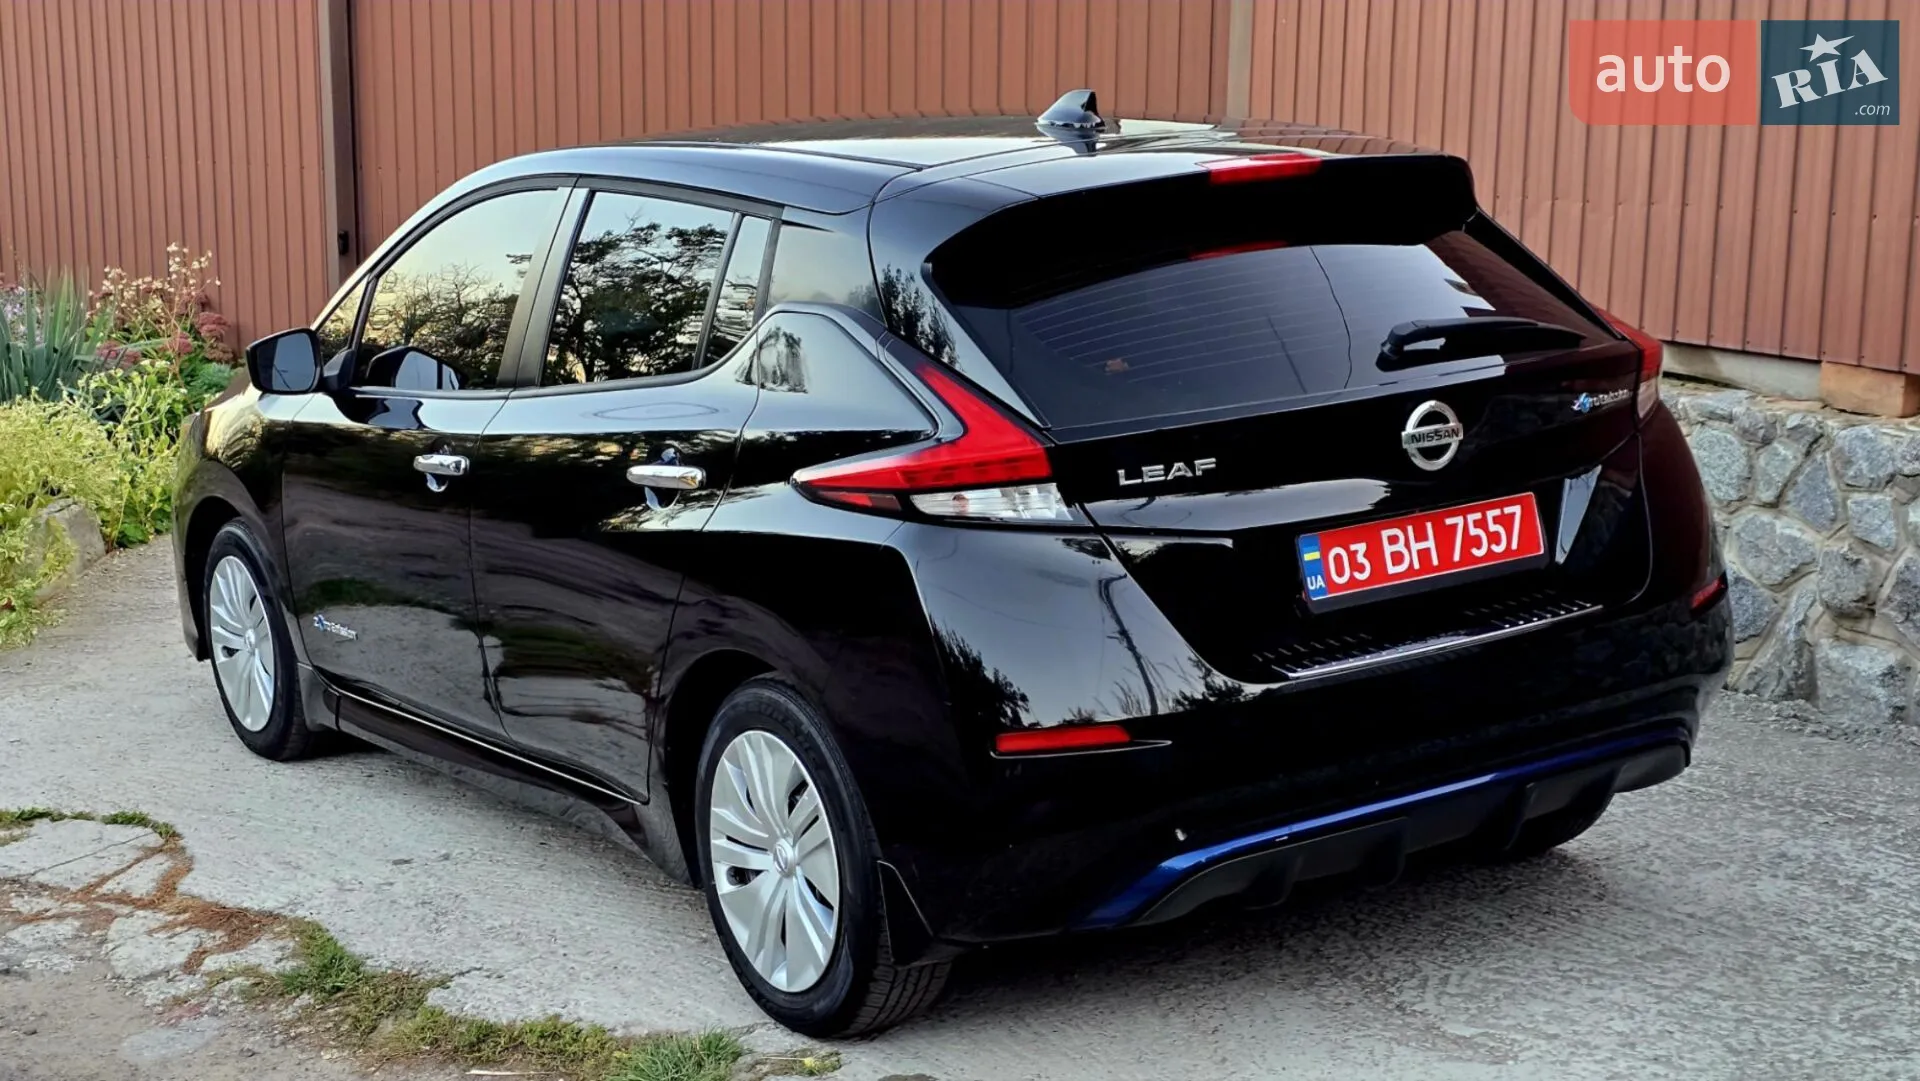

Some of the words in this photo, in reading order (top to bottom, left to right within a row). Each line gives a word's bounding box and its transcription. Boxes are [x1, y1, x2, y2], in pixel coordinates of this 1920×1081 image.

[1410, 428, 1460, 444] NISSAN
[1117, 457, 1217, 486] LEAF
[1327, 542, 1371, 584] 03
[1380, 521, 1439, 575] BH
[1444, 504, 1522, 562] 7557
[1306, 575, 1326, 590] UA
